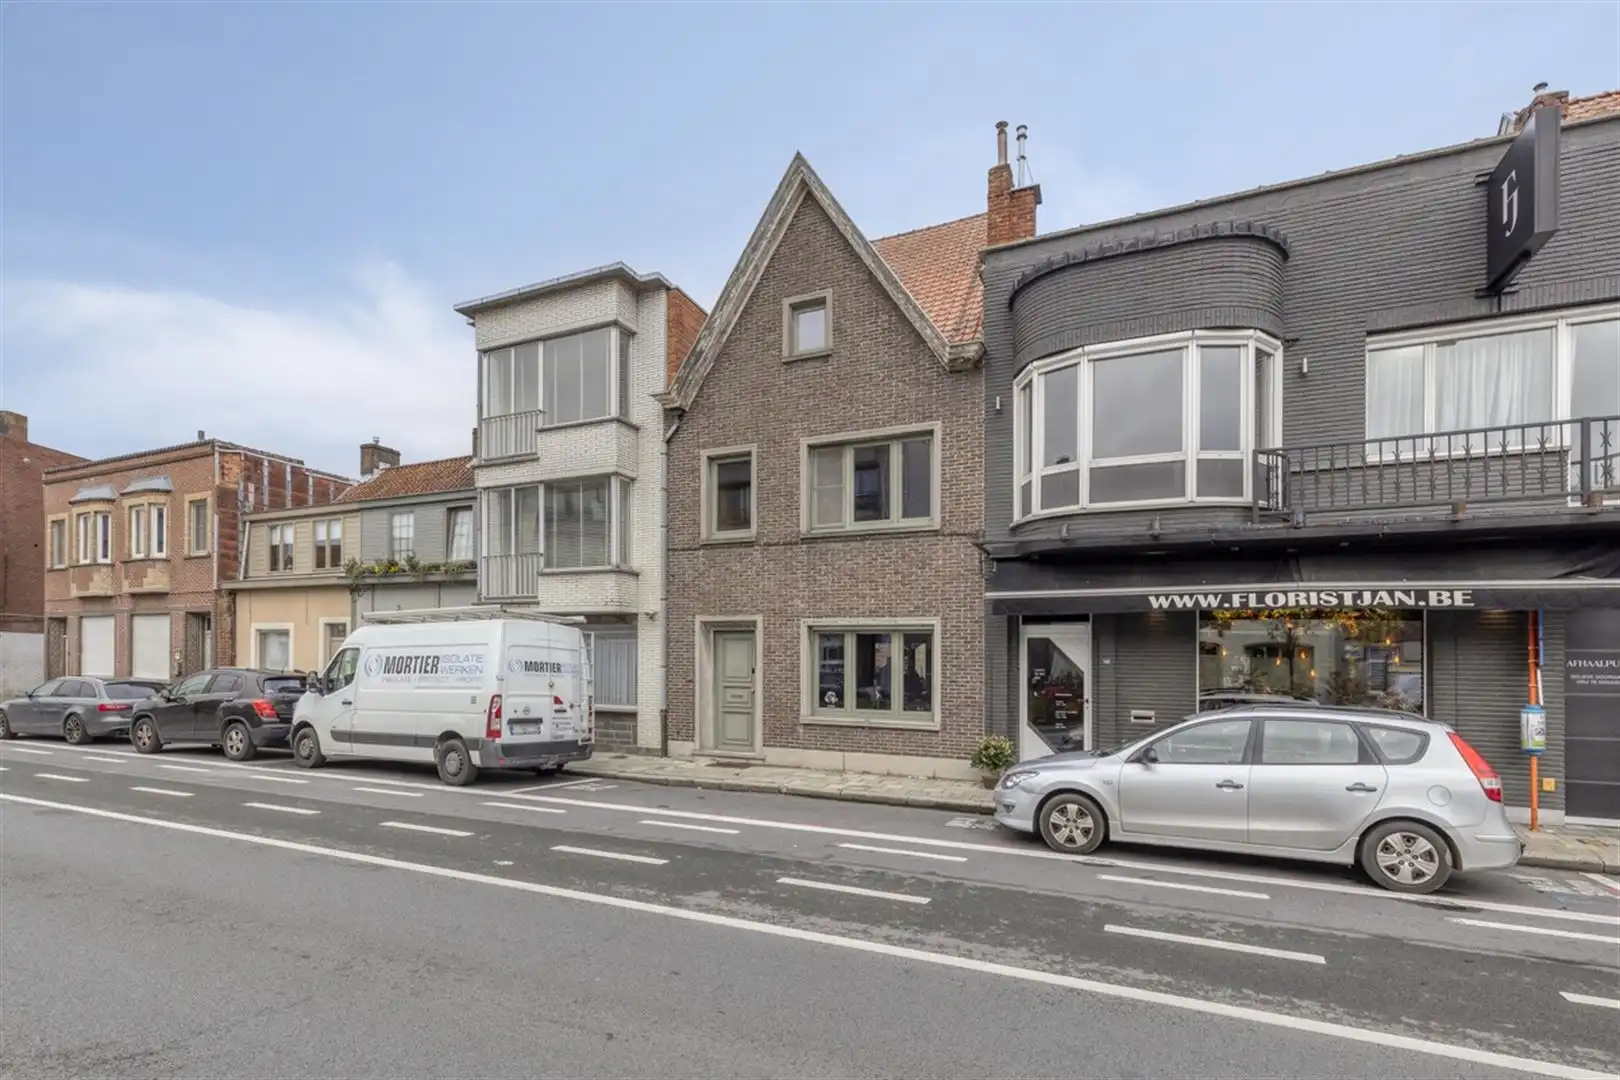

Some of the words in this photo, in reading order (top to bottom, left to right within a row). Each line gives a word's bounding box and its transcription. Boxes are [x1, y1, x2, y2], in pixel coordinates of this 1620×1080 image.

[1148, 589, 1475, 609] WWW.FLORISTJAN.BE
[383, 655, 441, 675] MORTIER
[440, 664, 484, 675] WERKEN
[524, 660, 562, 674] MORTIER
